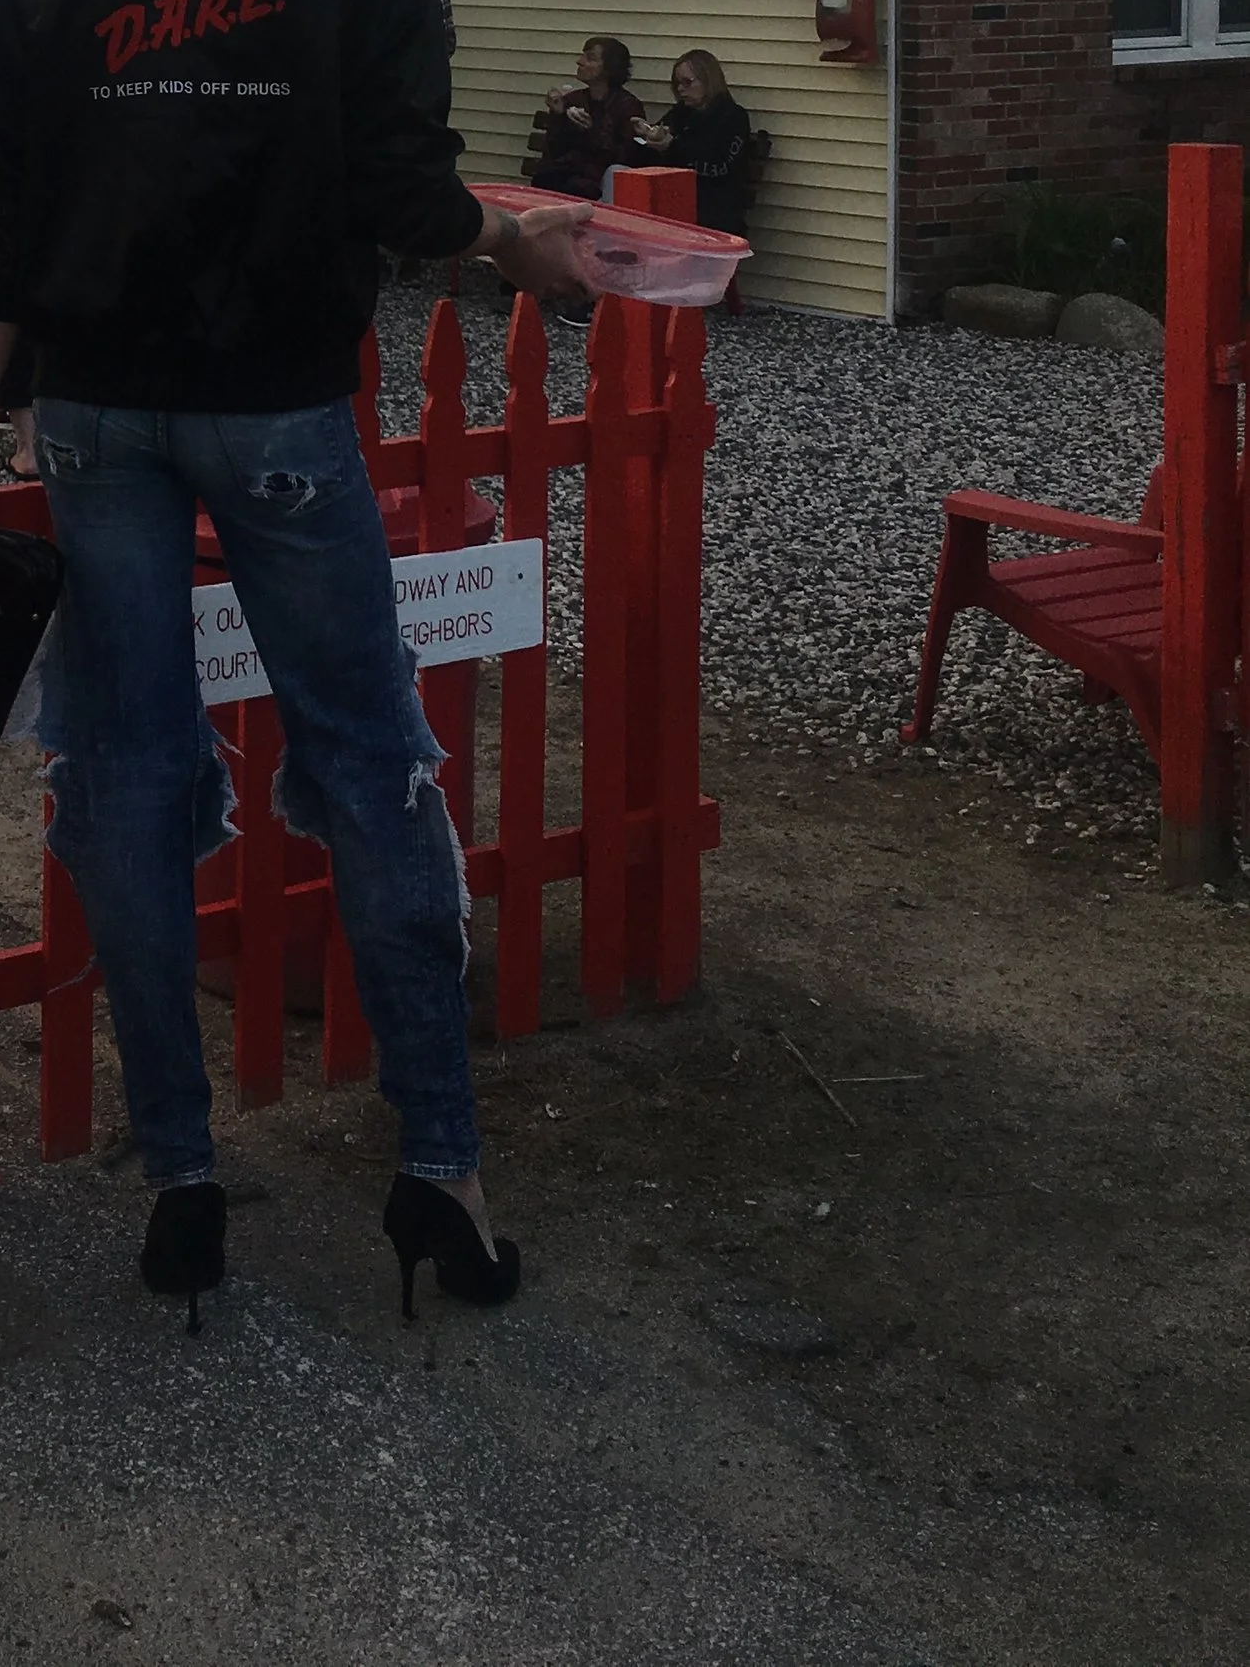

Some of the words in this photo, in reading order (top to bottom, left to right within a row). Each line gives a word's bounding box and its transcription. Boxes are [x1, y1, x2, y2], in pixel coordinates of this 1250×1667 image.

[90, 86, 111, 100] TO
[117, 81, 152, 98] KEEP
[159, 81, 193, 94] KIDS
[200, 82, 231, 95] OFF
[237, 83, 291, 96] DRUGS
[455, 566, 493, 594] AND
